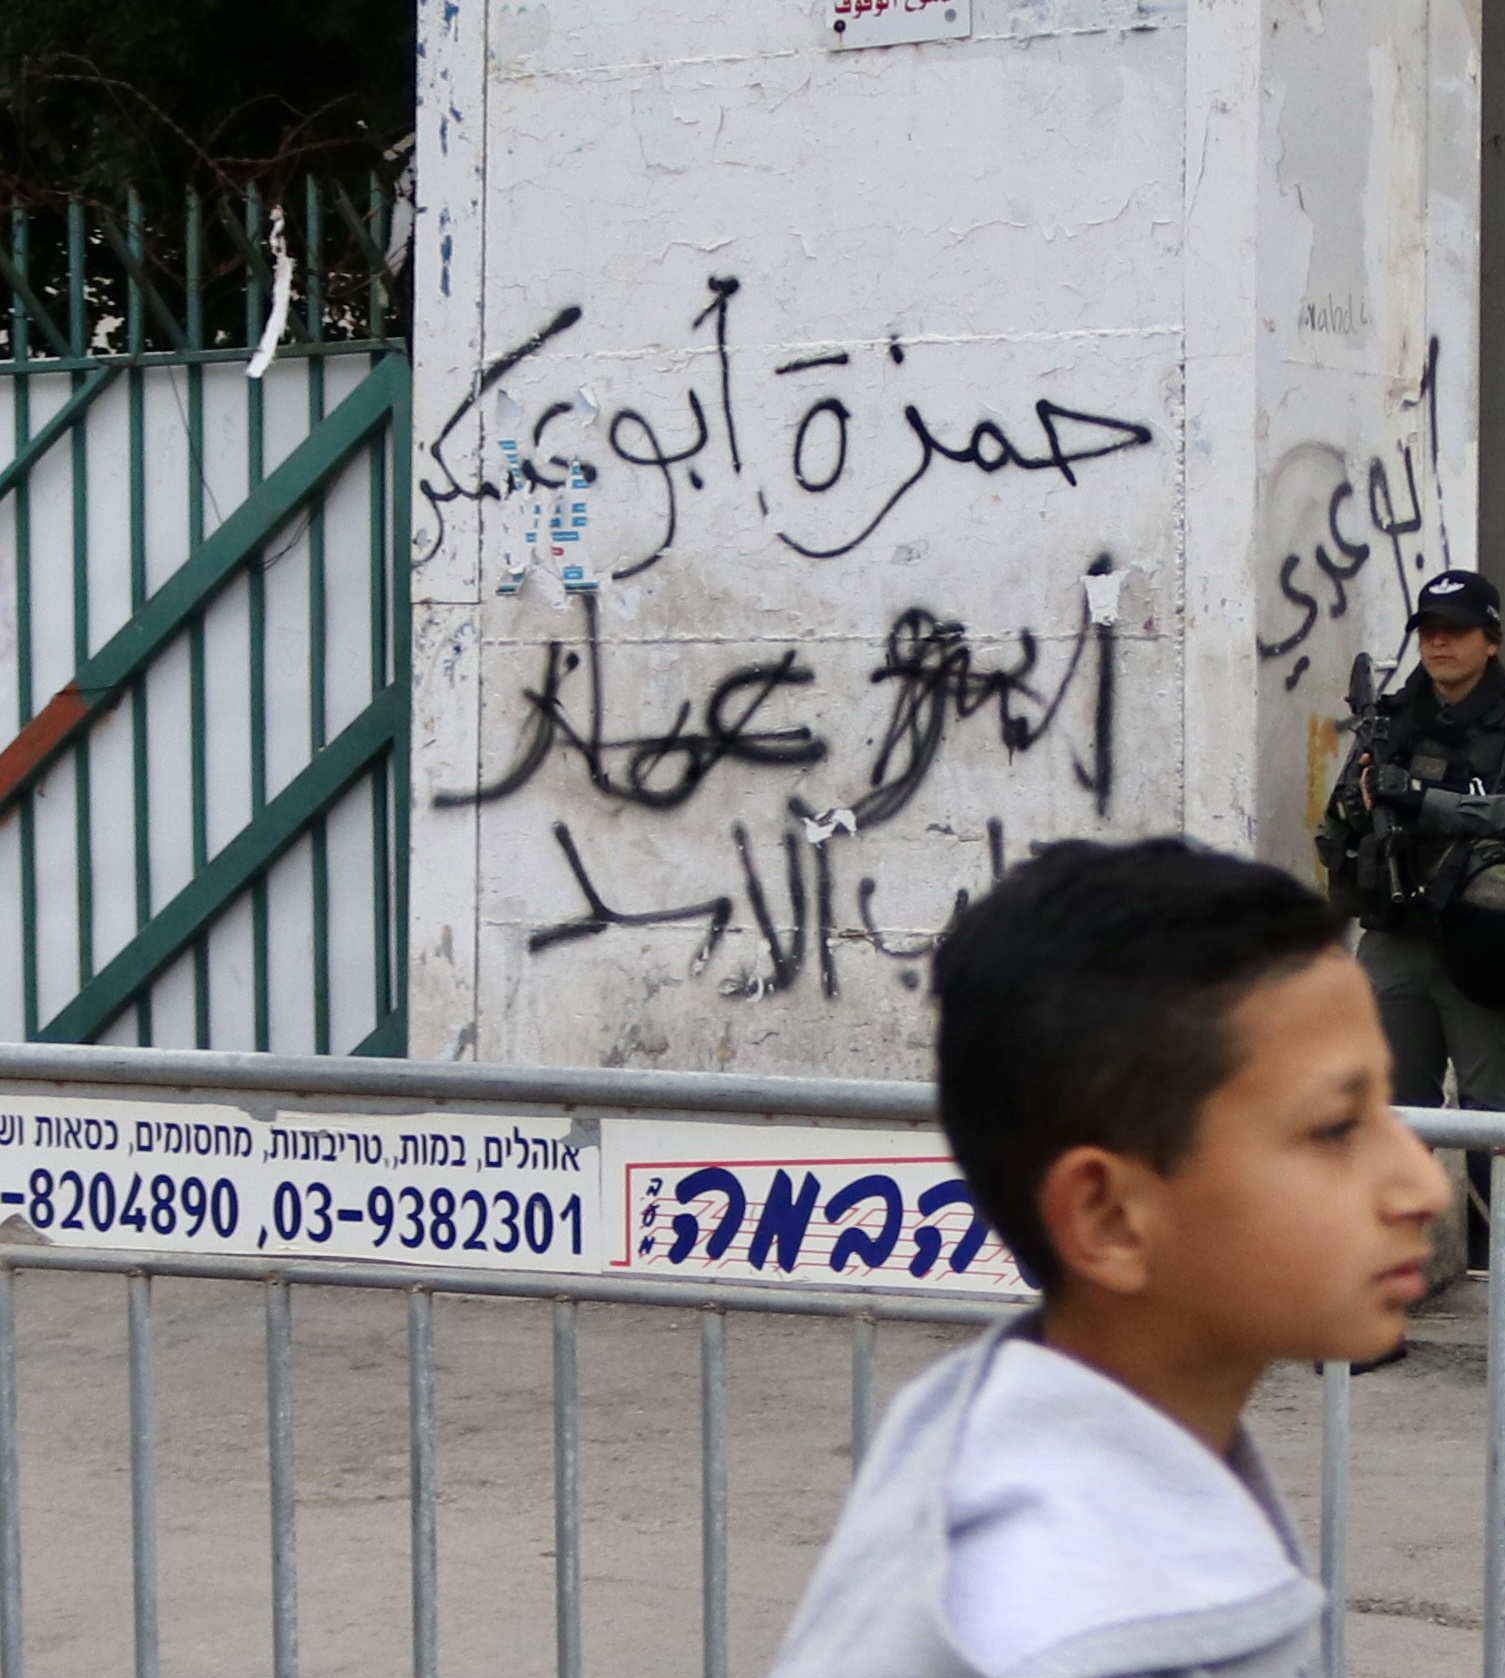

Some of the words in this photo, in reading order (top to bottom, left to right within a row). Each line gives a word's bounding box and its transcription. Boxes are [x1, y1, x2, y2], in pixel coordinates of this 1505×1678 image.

[764, 334, 1152, 559] حمزة
[33, 1115, 119, 1151] כסאות
[128, 1120, 253, 1157] מחסומים,
